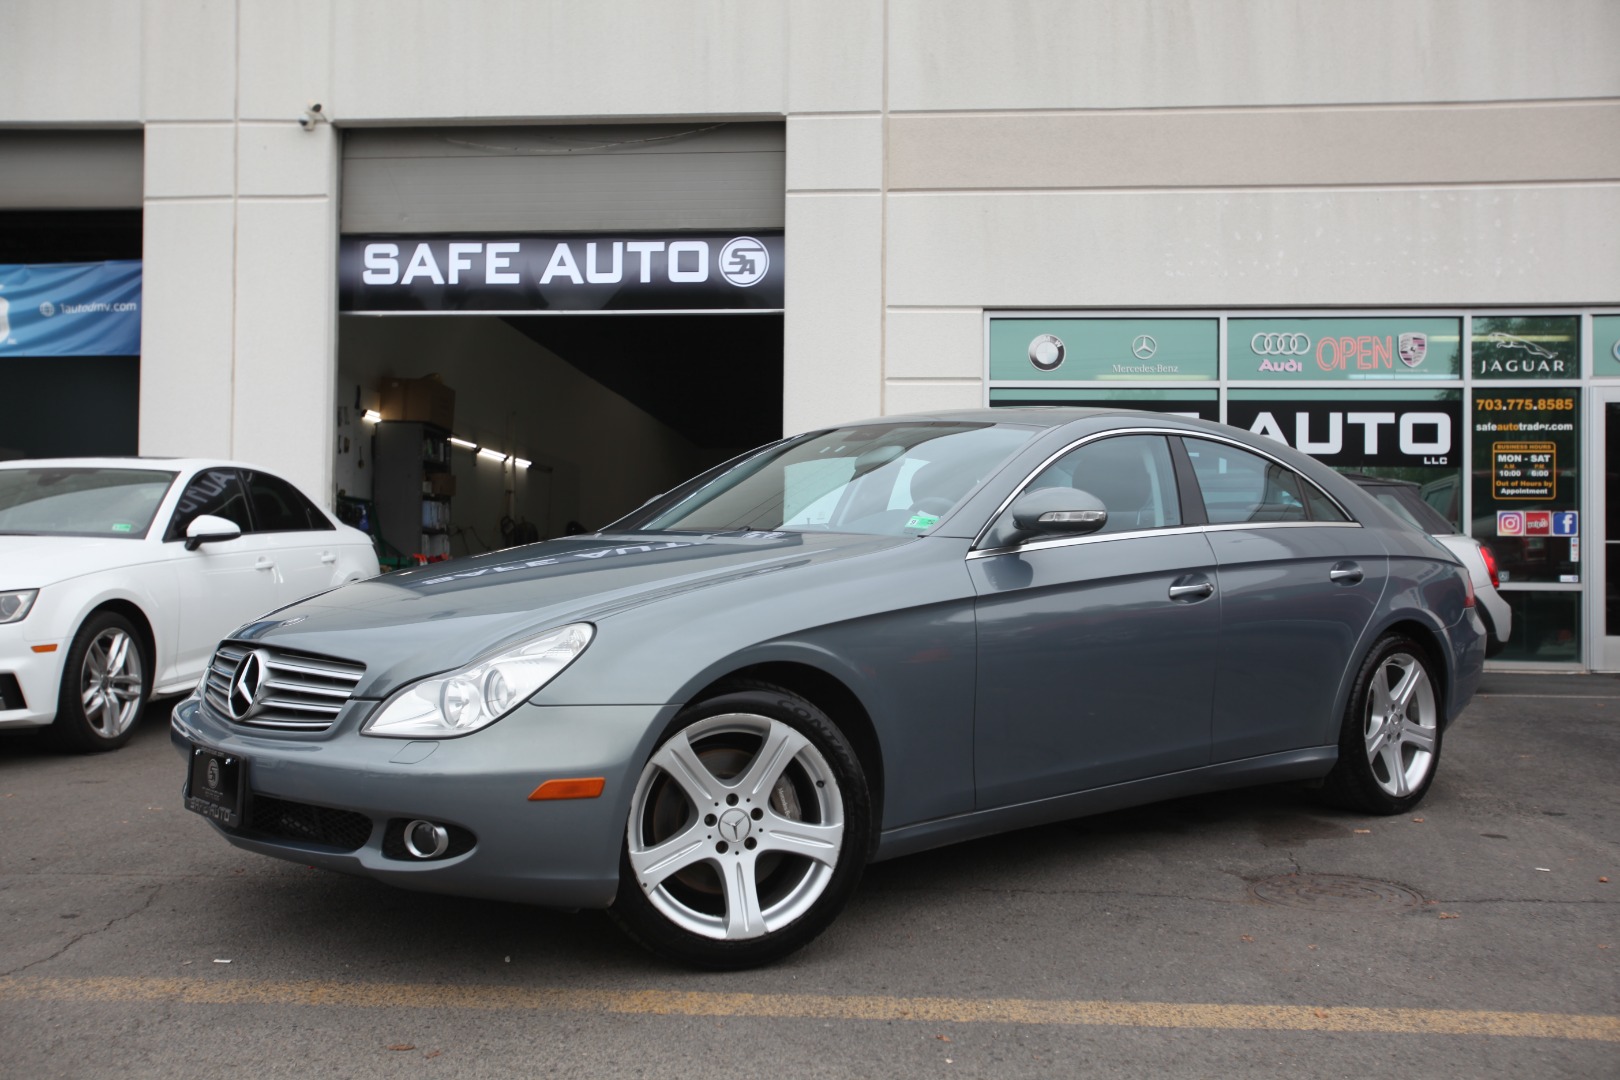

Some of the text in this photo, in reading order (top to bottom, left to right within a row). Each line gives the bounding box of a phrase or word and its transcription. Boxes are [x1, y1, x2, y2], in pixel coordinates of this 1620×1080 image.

[362, 241, 709, 285] SAFE AUTO
[60, 302, 137, 314] 1autodmv.com
[1316, 336, 1393, 371] OPEN
[1112, 364, 1179, 373] Mercedes-Benz
[1258, 359, 1303, 372] Audi
[1481, 360, 1565, 374] JAGUAR
[1476, 398, 1574, 411] 703.775.8585
[1476, 422, 1573, 432] safeautotrader.com
[1250, 412, 1451, 455] AUTO
[1423, 456, 1448, 465] LLC
[1497, 454, 1522, 463] MON
[1530, 454, 1551, 463] SAT
[1543, 480, 1553, 488] by
